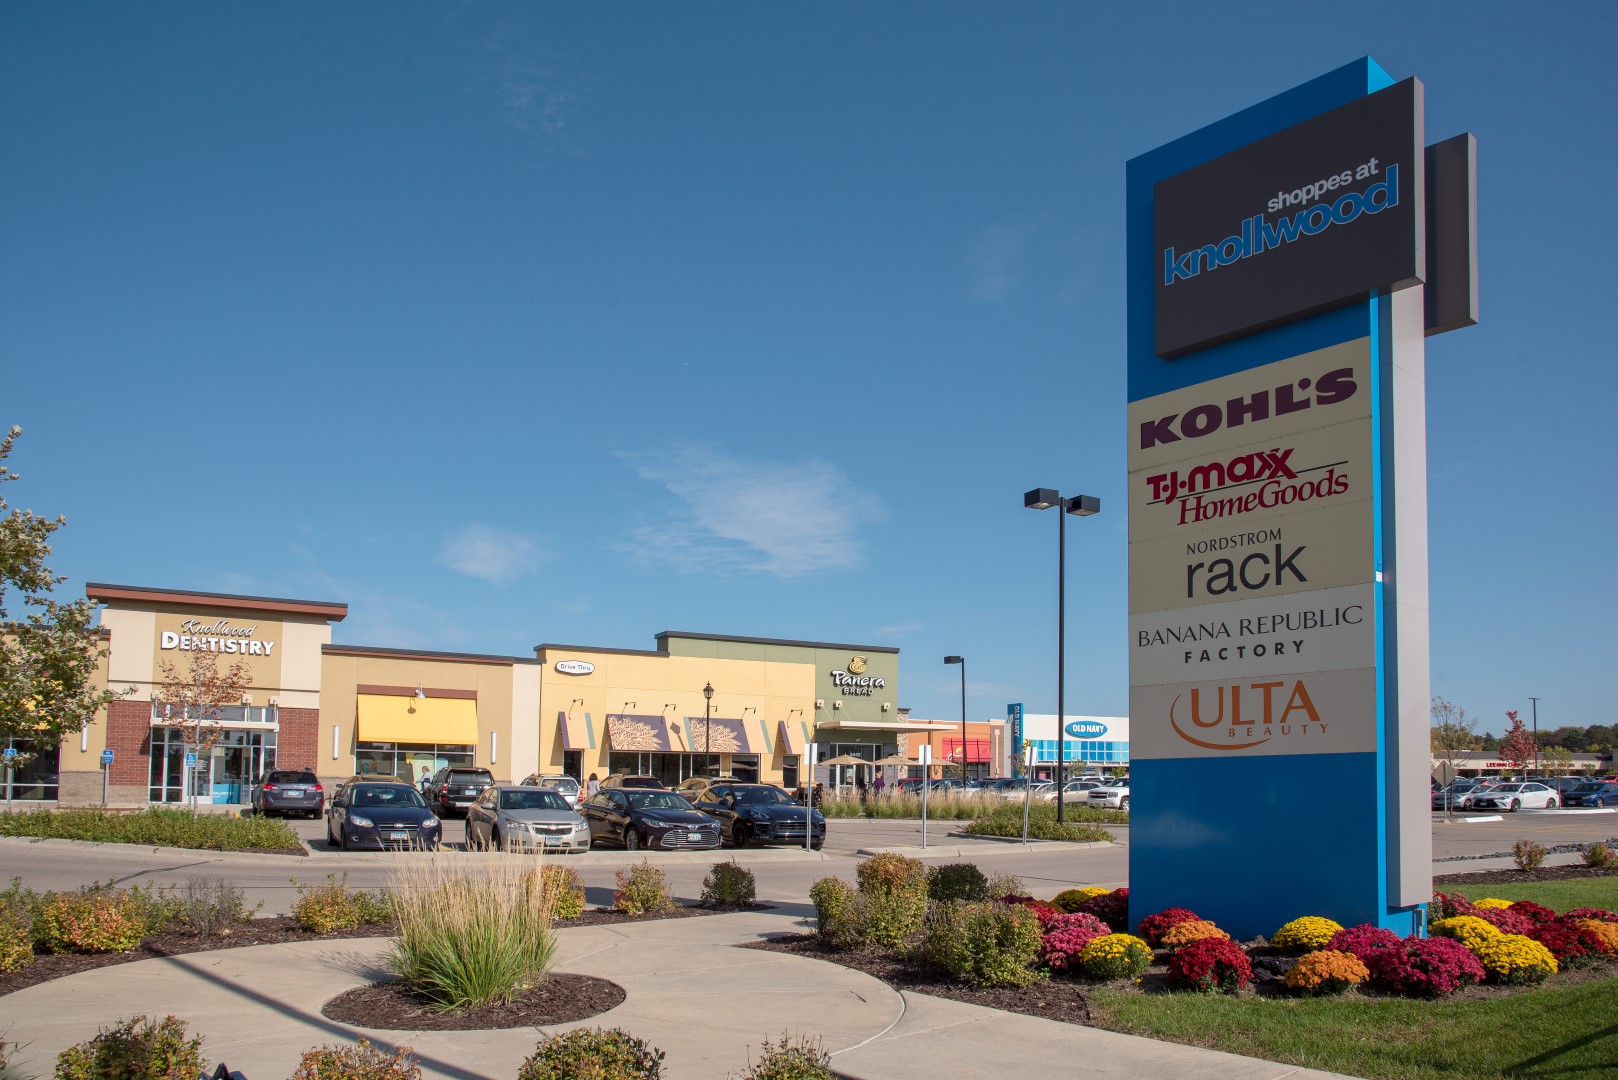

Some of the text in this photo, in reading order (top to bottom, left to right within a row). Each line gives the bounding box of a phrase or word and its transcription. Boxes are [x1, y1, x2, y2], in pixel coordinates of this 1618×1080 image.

[1267, 157, 1379, 213] shoppes at
[1164, 163, 1399, 286] knollwood
[1140, 367, 1358, 450] KOHL'S
[1177, 467, 1349, 525] HomeGoods
[1186, 527, 1282, 555] NORDSTROM
[1187, 543, 1308, 598] rack
[181, 619, 258, 637] Knollwood
[1138, 605, 1363, 647] BANANA REPUBLIC
[161, 630, 275, 655] DENTISTRY
[1184, 640, 1304, 664] FACTORY
[831, 670, 886, 687] Panera
[843, 687, 874, 695] BREAD
[1190, 679, 1321, 728] ULTA
[1072, 724, 1105, 734] OLD NAVY
[1228, 723, 1328, 738] BEAUTY
